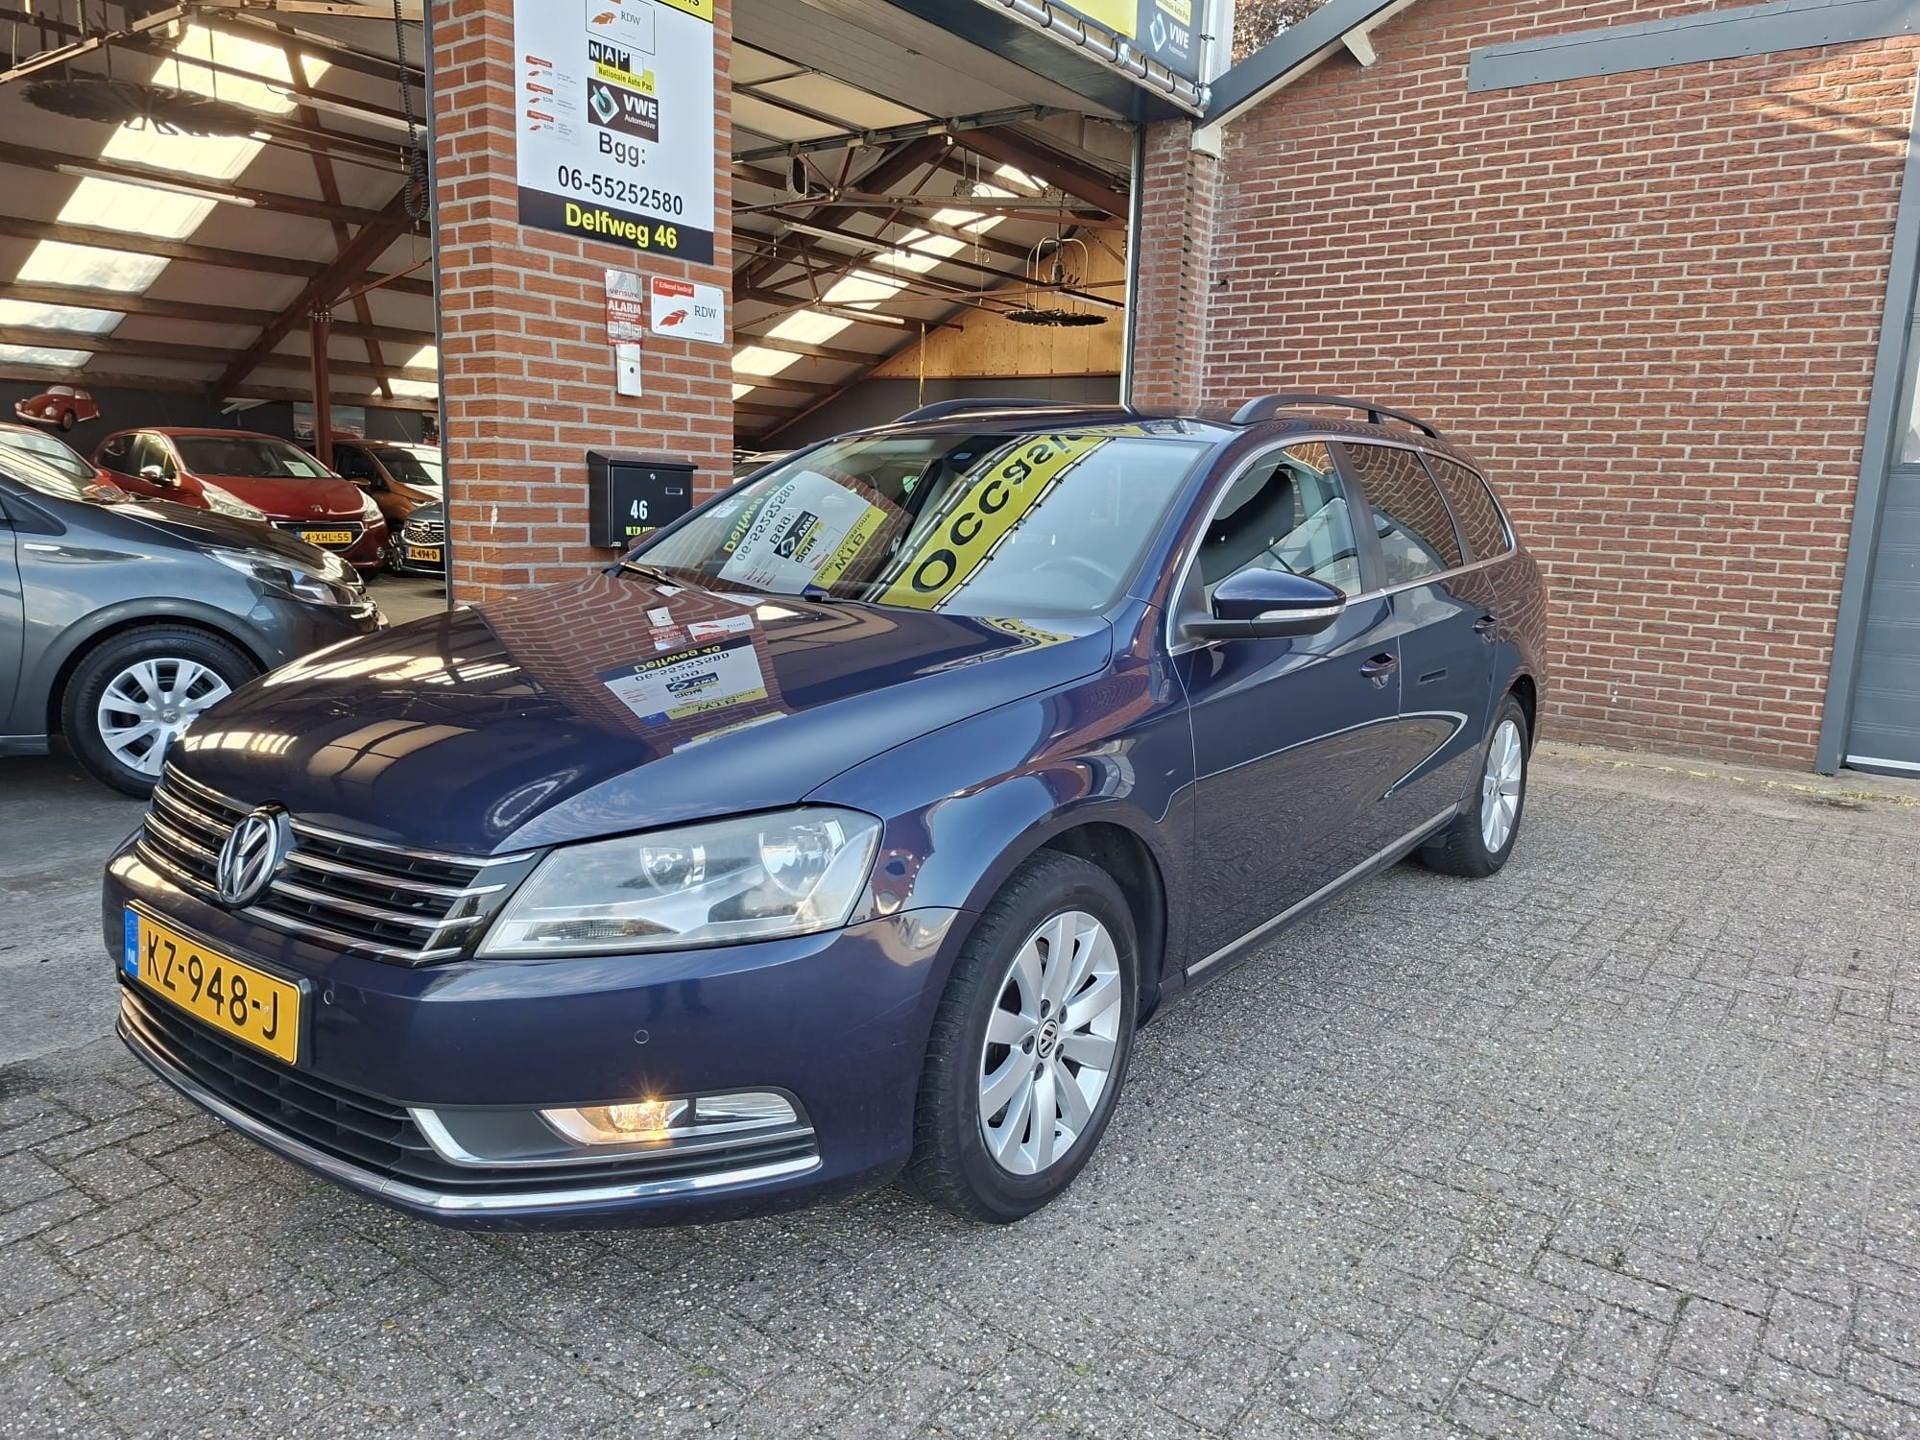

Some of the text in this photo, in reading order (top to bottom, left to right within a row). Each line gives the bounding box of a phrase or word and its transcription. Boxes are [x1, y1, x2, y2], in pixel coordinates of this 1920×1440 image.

[620, 10, 641, 25] RDW
[1169, 22, 1190, 49] VWE
[589, 42, 629, 64] NAP
[598, 66, 653, 91] Nationale Auto Pas
[623, 94, 657, 119] VWE
[624, 113, 656, 130] Automotive
[599, 131, 646, 167] Bgg:
[558, 165, 683, 215] 06-55252580
[565, 203, 678, 249] Delfweg 46
[608, 299, 641, 314] ALARM
[694, 305, 717, 319] RDW
[630, 499, 648, 520] 46
[305, 531, 350, 542] 4-XHL-55
[147, 930, 278, 1041] KZ-948-J
